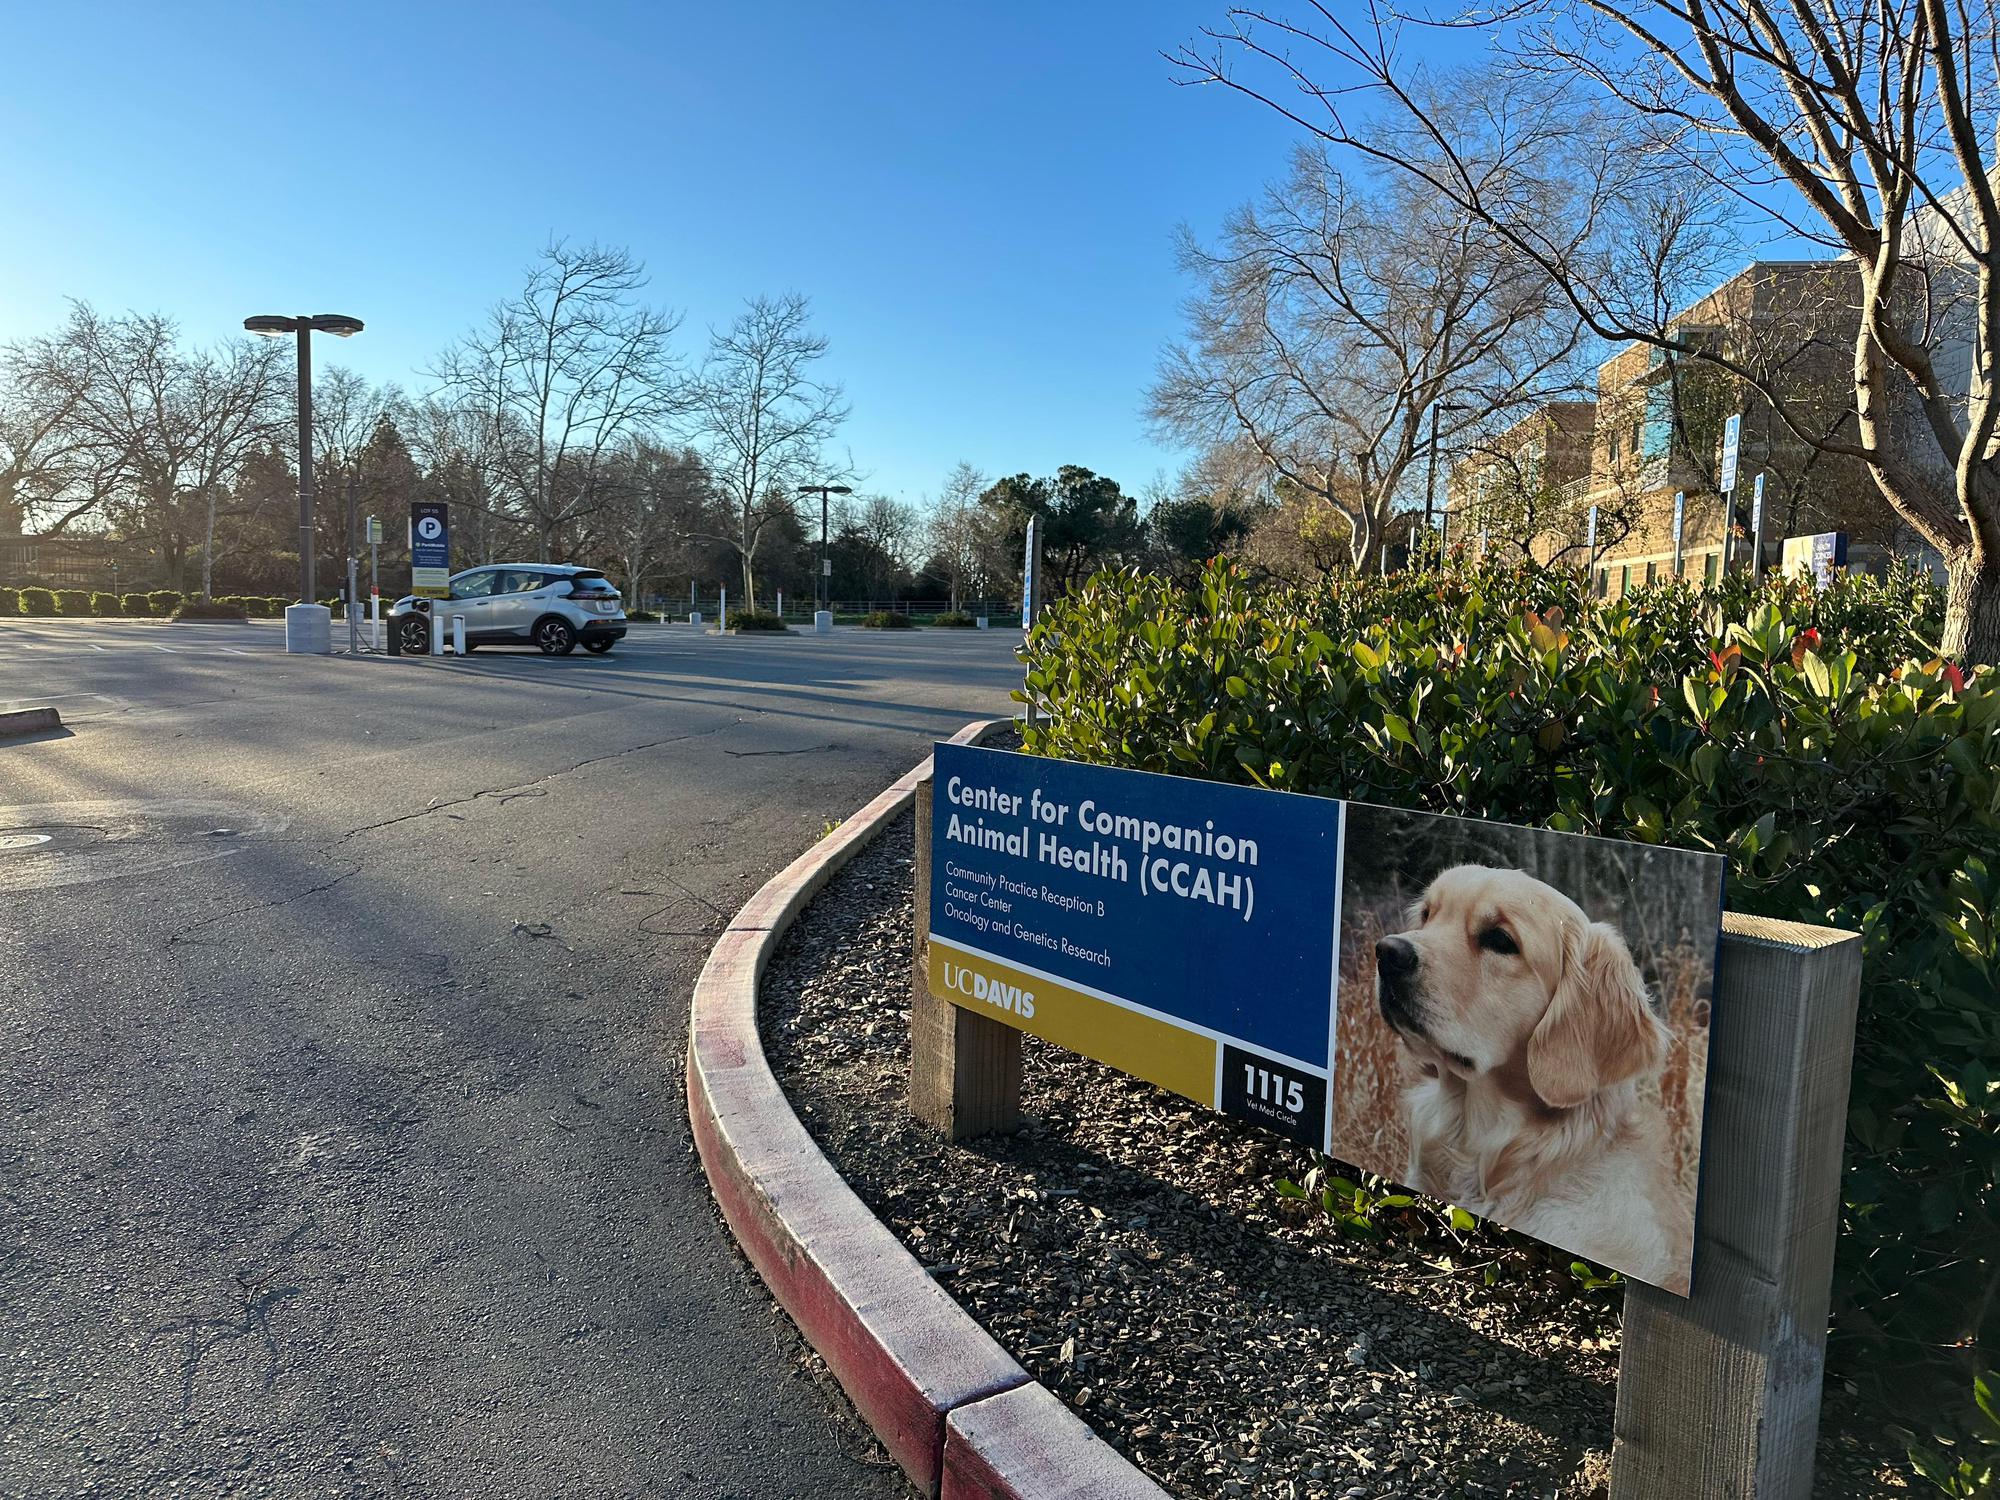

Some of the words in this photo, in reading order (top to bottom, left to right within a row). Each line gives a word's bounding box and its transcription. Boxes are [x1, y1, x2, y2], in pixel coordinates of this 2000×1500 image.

[425, 522, 435, 534] P
[947, 776, 1022, 817] Center
[1031, 789, 1069, 826] for
[1078, 800, 1258, 866] Companion
[945, 861, 997, 891] Community
[999, 875, 1038, 899] Practice
[1041, 886, 1093, 914] Reception
[1097, 901, 1105, 917] B
[946, 813, 1028, 858] Animal
[1038, 832, 1128, 882] Health
[1140, 855, 1254, 922] (CCAH)
[945, 882, 978, 904] Cancer
[980, 892, 1012, 914] Center
[944, 902, 990, 932] Oncology
[991, 920, 1011, 935] and
[1013, 924, 1058, 951] Genetics
[1061, 938, 1111, 968] Research
[1244, 1063, 1304, 1113] 1115
[1246, 1098, 1258, 1111] Vet
[1259, 1105, 1275, 1117] Med
[1276, 1111, 1297, 1126] Circle
